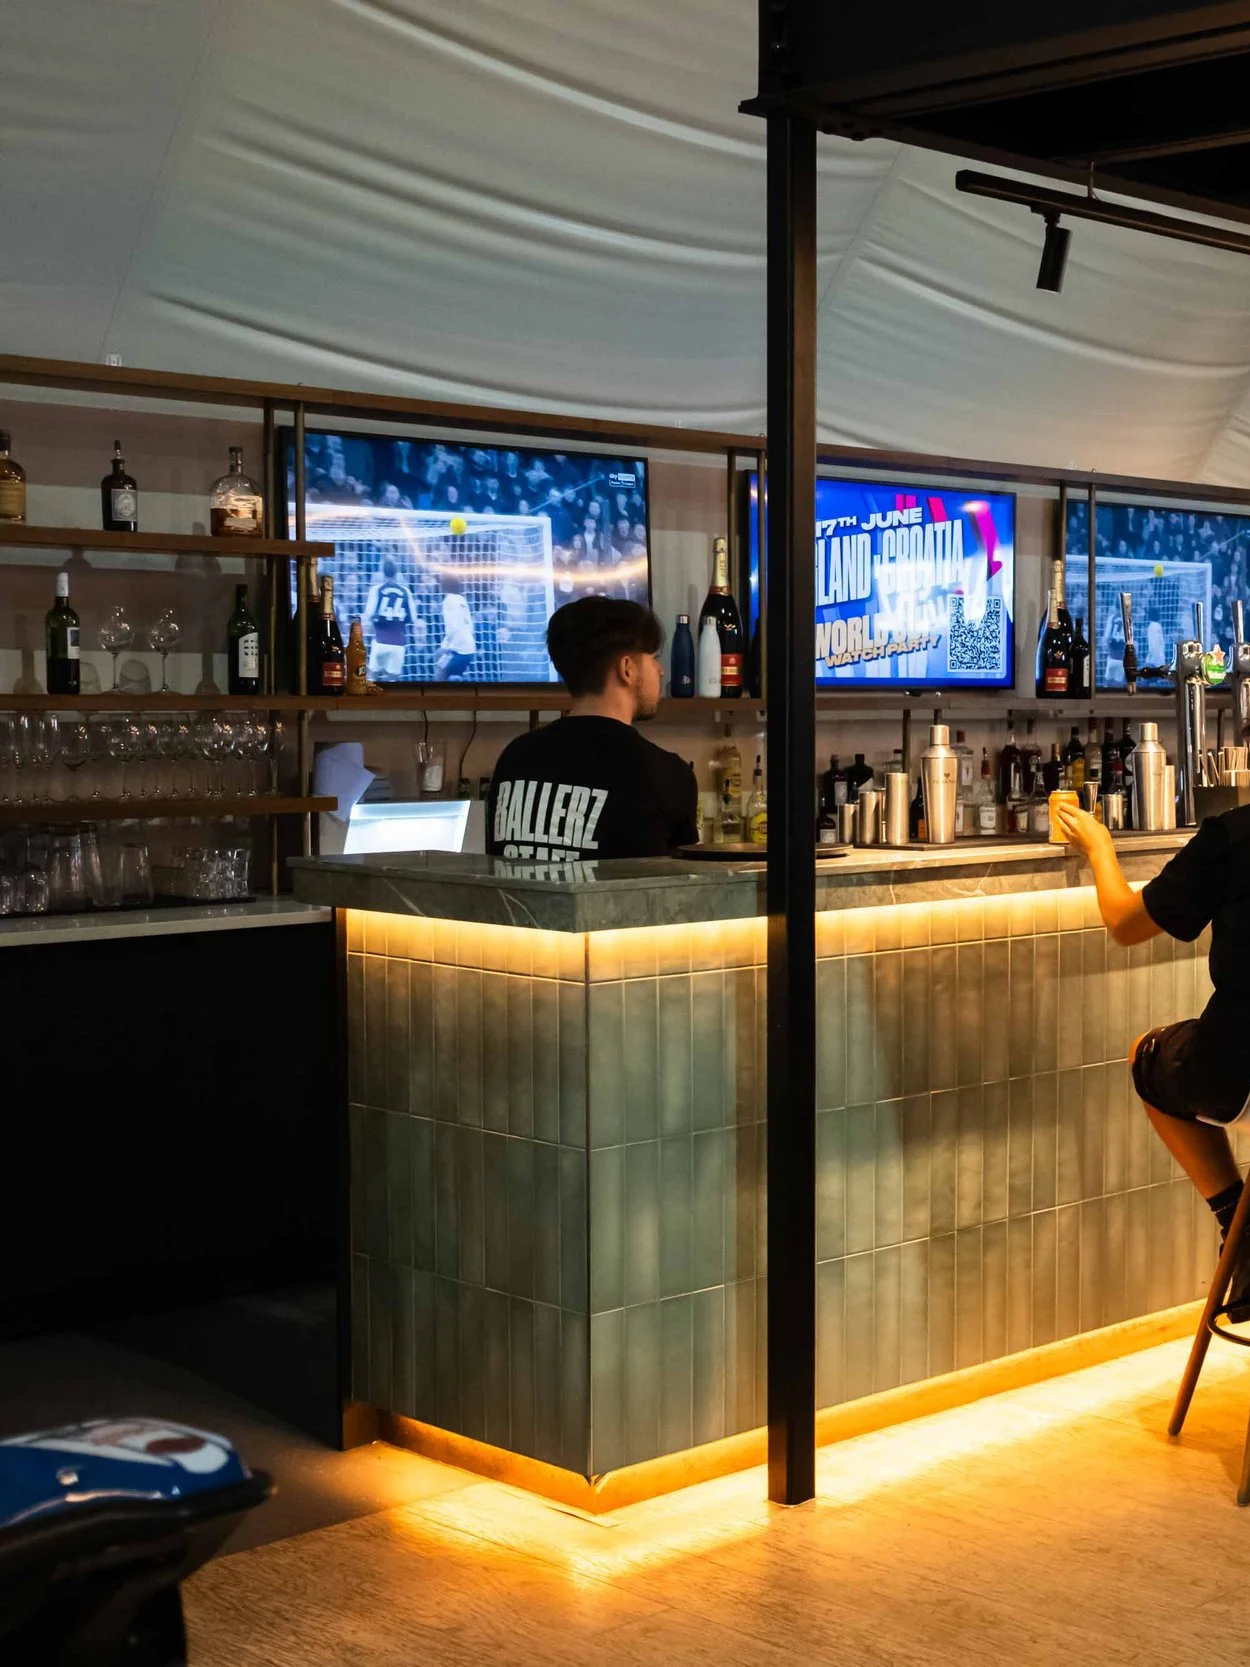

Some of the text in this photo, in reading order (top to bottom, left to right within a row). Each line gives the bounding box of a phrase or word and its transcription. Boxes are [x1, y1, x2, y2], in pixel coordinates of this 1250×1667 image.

[861, 506, 922, 531] JUNE
[816, 532, 871, 606] LAND
[825, 635, 941, 668] WATCH PARTY
[494, 779, 609, 850] BALLERZ
